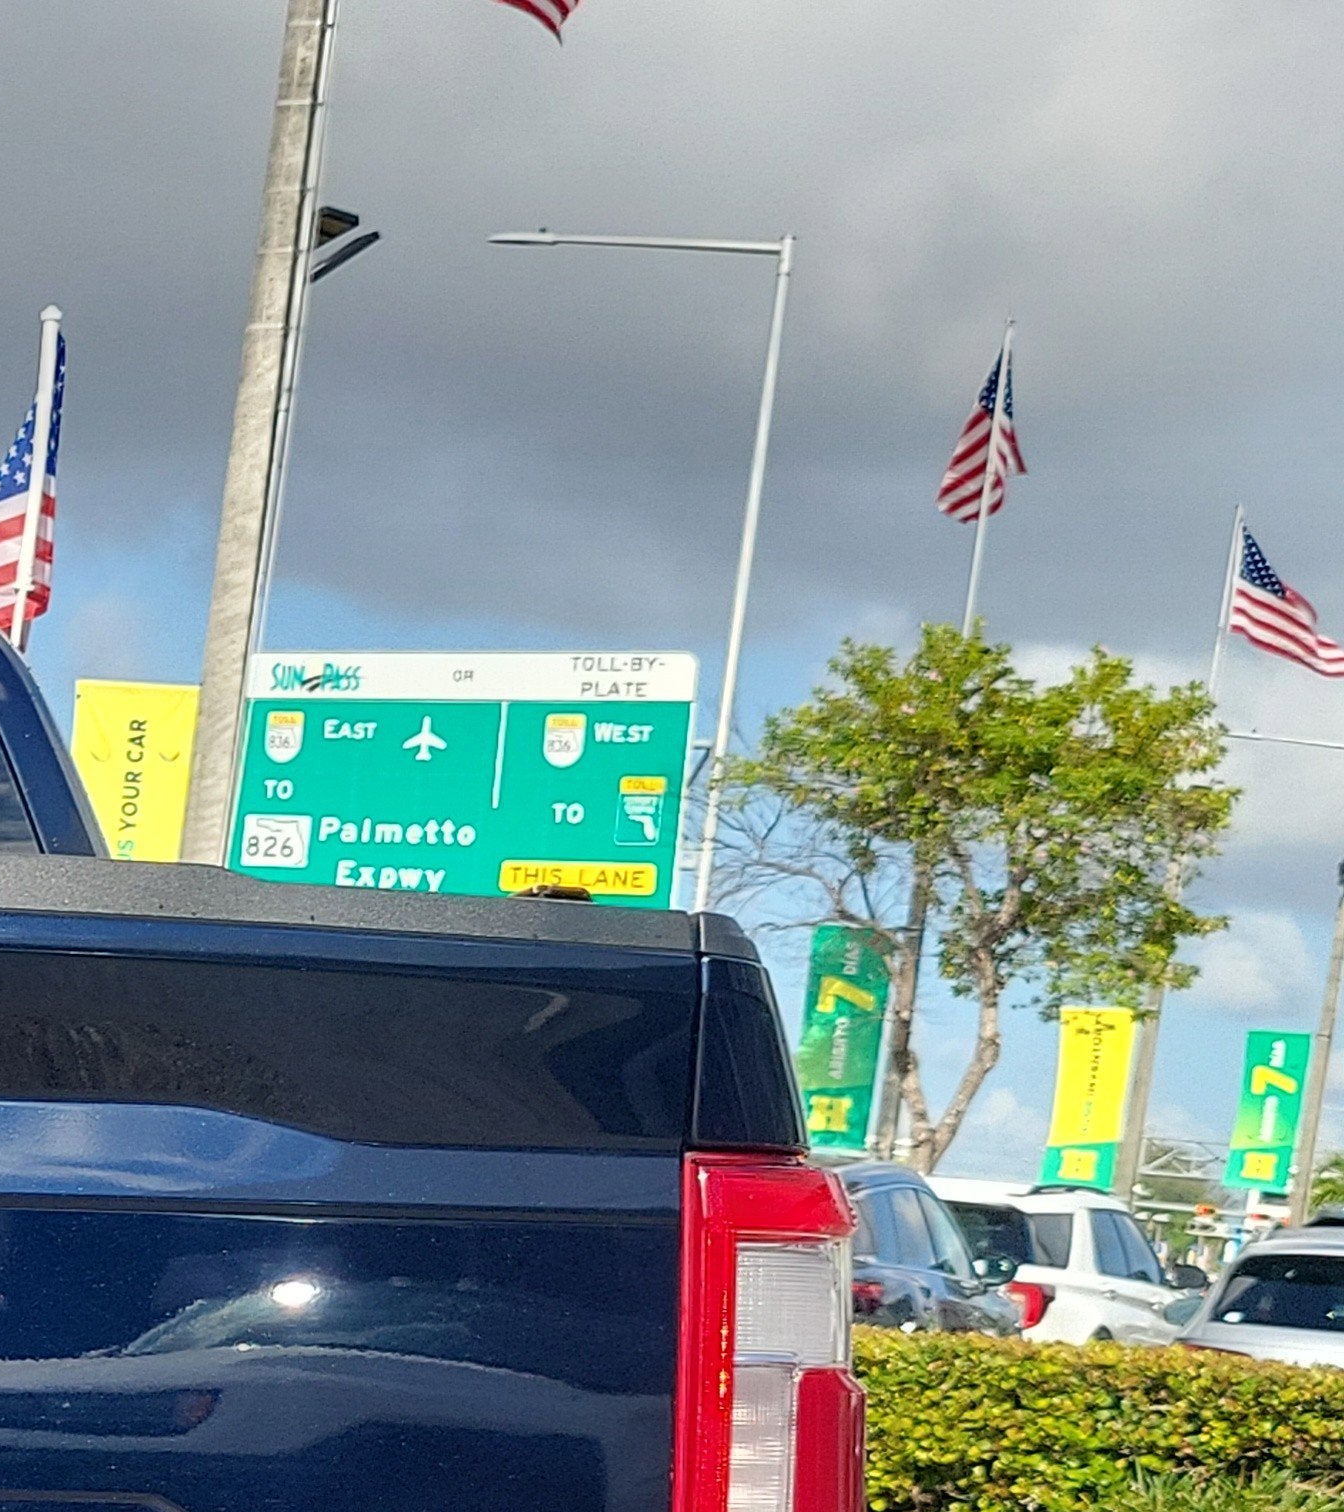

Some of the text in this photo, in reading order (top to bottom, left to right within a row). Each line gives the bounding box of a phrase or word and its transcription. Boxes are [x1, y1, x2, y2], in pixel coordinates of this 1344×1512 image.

[452, 669, 475, 682] OR
[580, 682, 648, 697] PLATE
[323, 719, 378, 740] EAST
[593, 722, 655, 743] WEST
[126, 719, 148, 763] CAR
[264, 779, 294, 800] TO
[626, 779, 657, 791] TOLL
[118, 771, 143, 831] YOUR
[552, 802, 585, 825] TO
[318, 816, 476, 847] Palmetto
[246, 836, 294, 858] 826
[510, 866, 645, 888] THIS LANE
[816, 976, 875, 1014] 7
[1250, 1064, 1299, 1095] 7
